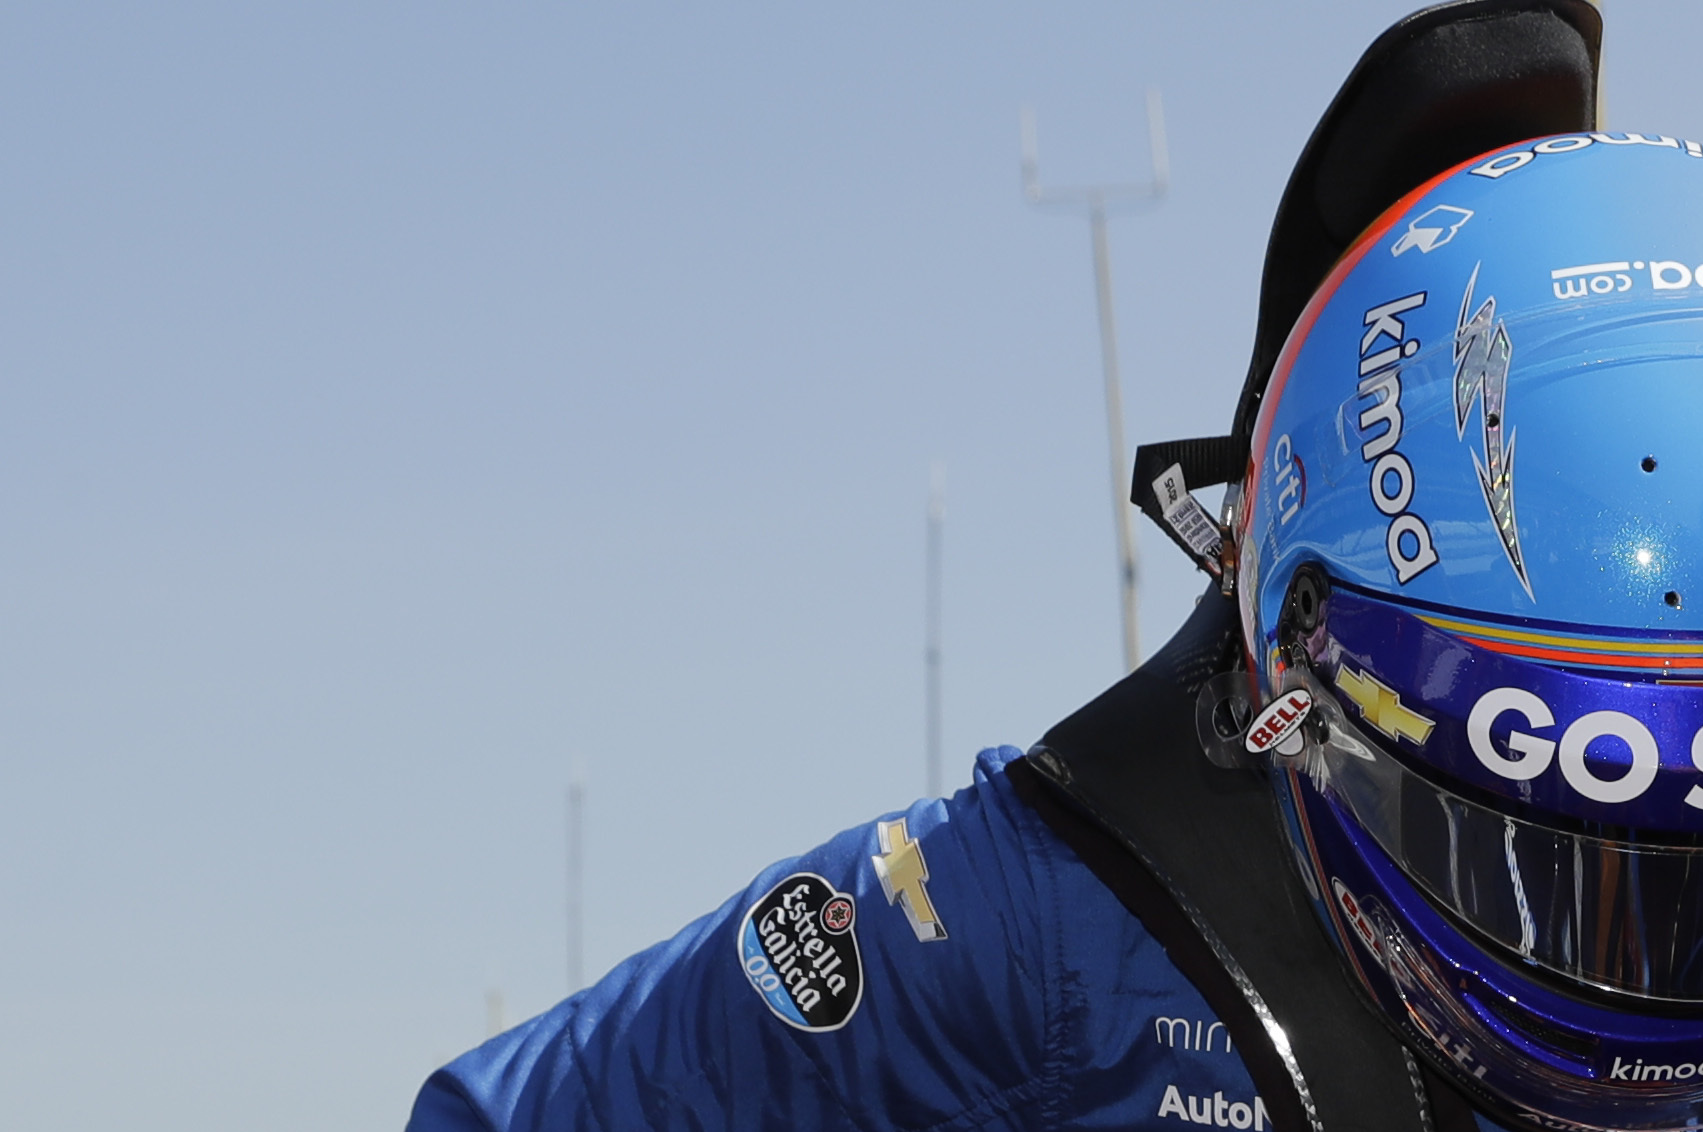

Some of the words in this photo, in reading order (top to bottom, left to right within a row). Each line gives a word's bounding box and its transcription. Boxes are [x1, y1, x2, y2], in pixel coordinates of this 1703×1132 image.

[1273, 433, 1302, 526] citi
[1359, 291, 1439, 584] kimoa
[1248, 696, 1311, 749] BELL
[1466, 686, 1658, 804] GO
[758, 906, 821, 1012] Galicia
[783, 884, 847, 997] Estrella
